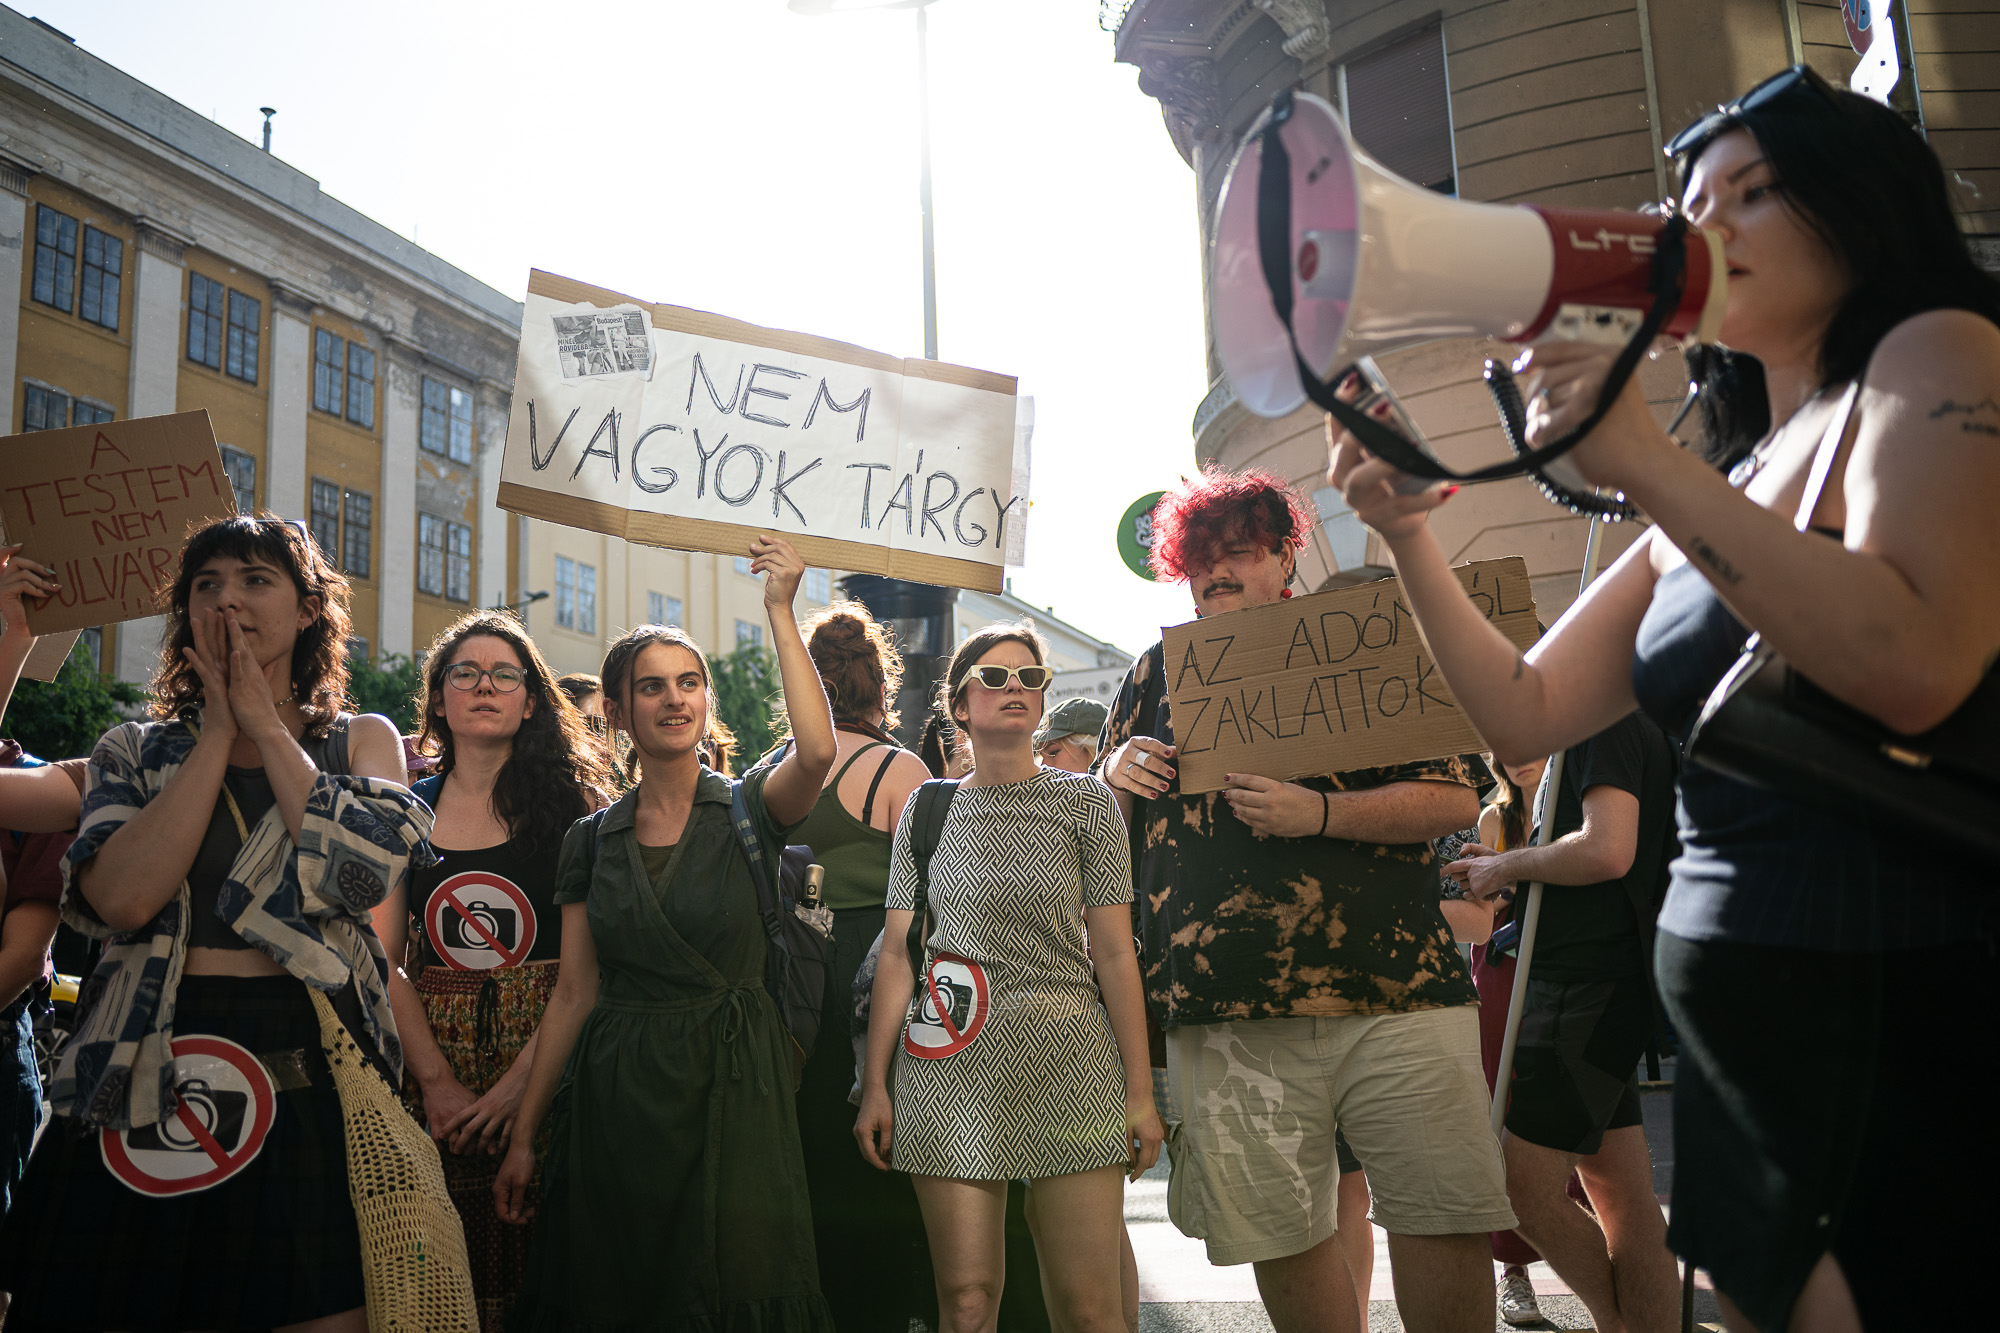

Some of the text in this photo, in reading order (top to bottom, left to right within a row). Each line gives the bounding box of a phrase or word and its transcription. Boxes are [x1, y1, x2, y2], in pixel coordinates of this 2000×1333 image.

[686, 352, 871, 443] NEM
[90, 431, 131, 470] A
[527, 398, 1024, 549] VAGYOK TÁRGY
[5, 460, 221, 525] TESTEM
[92, 510, 168, 546] NEM
[32, 547, 186, 611] ULVÁR
[1175, 571, 1530, 693] AZ ADÓÓL
[1180, 655, 1455, 756] ZAKLATTOK
